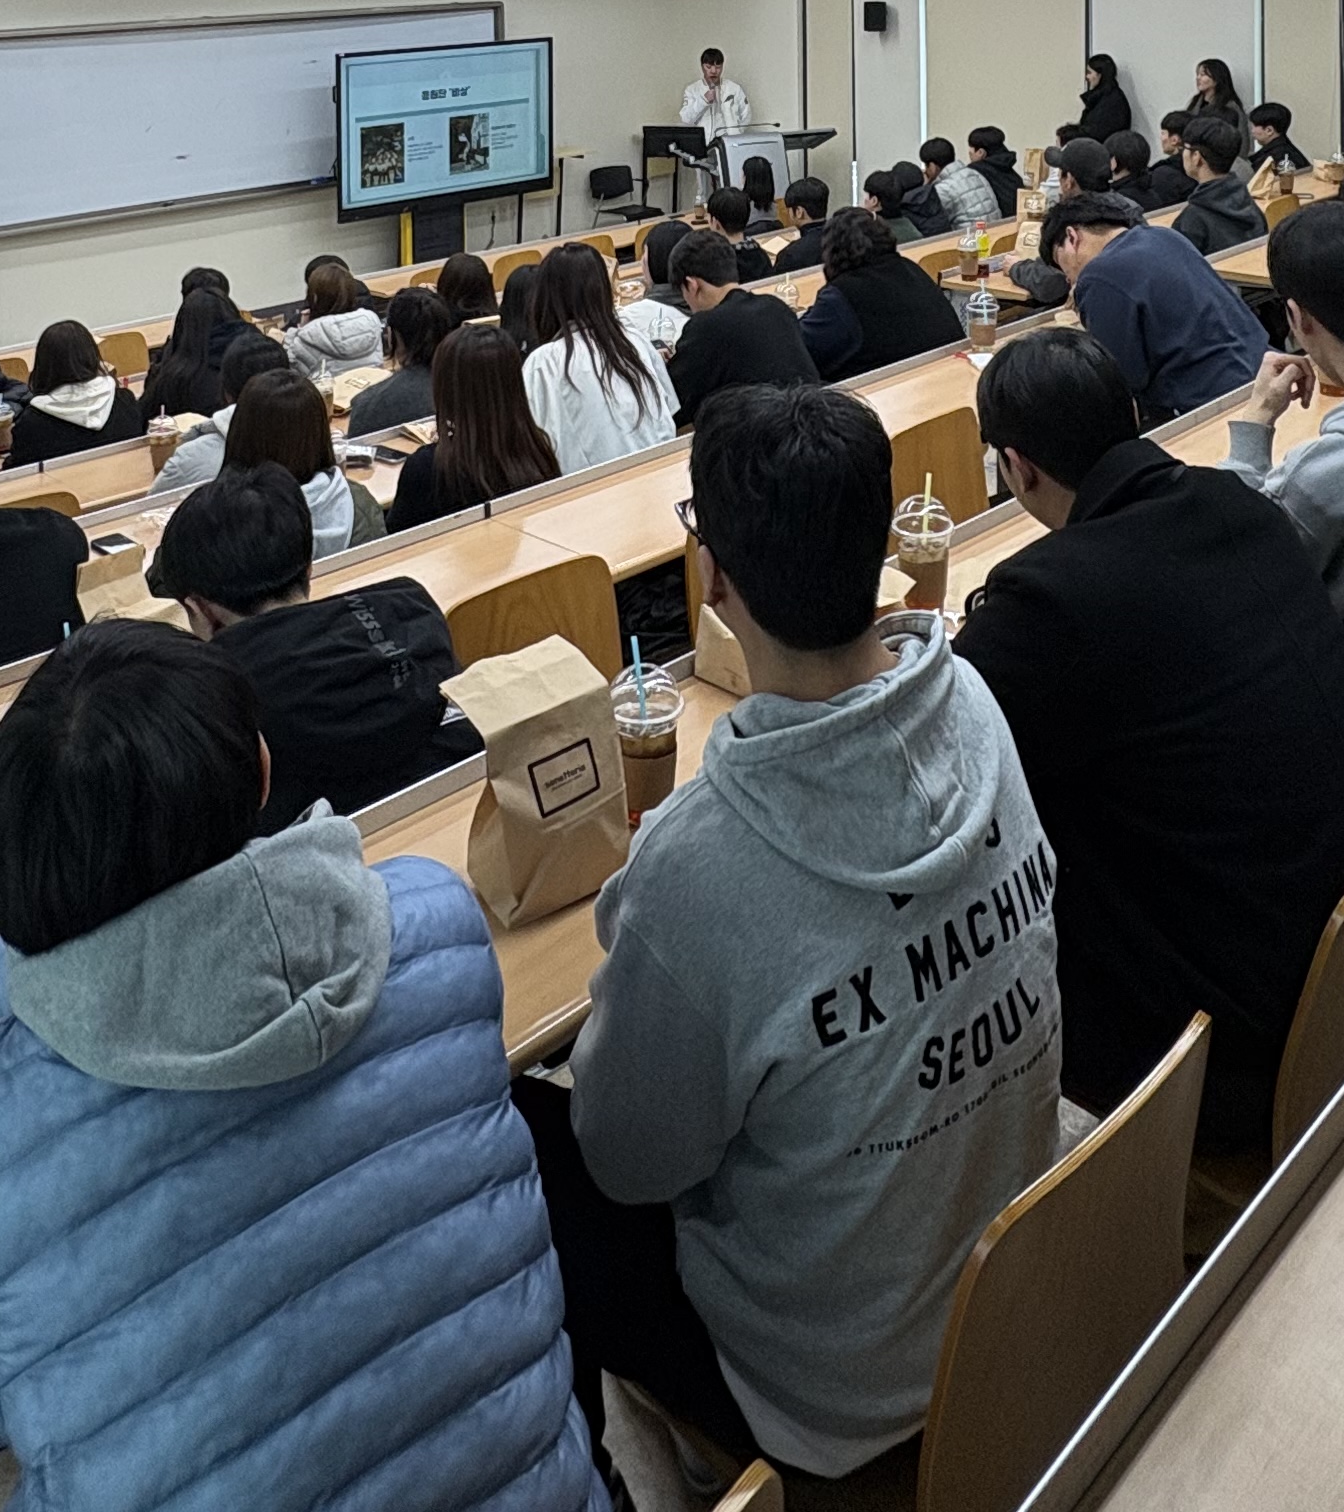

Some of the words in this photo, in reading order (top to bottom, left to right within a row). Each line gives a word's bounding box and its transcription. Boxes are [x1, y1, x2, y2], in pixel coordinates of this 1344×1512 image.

[811, 965, 888, 1048] EX
[904, 840, 1054, 1003] MACHINA
[917, 976, 1041, 1090] SEOUL
